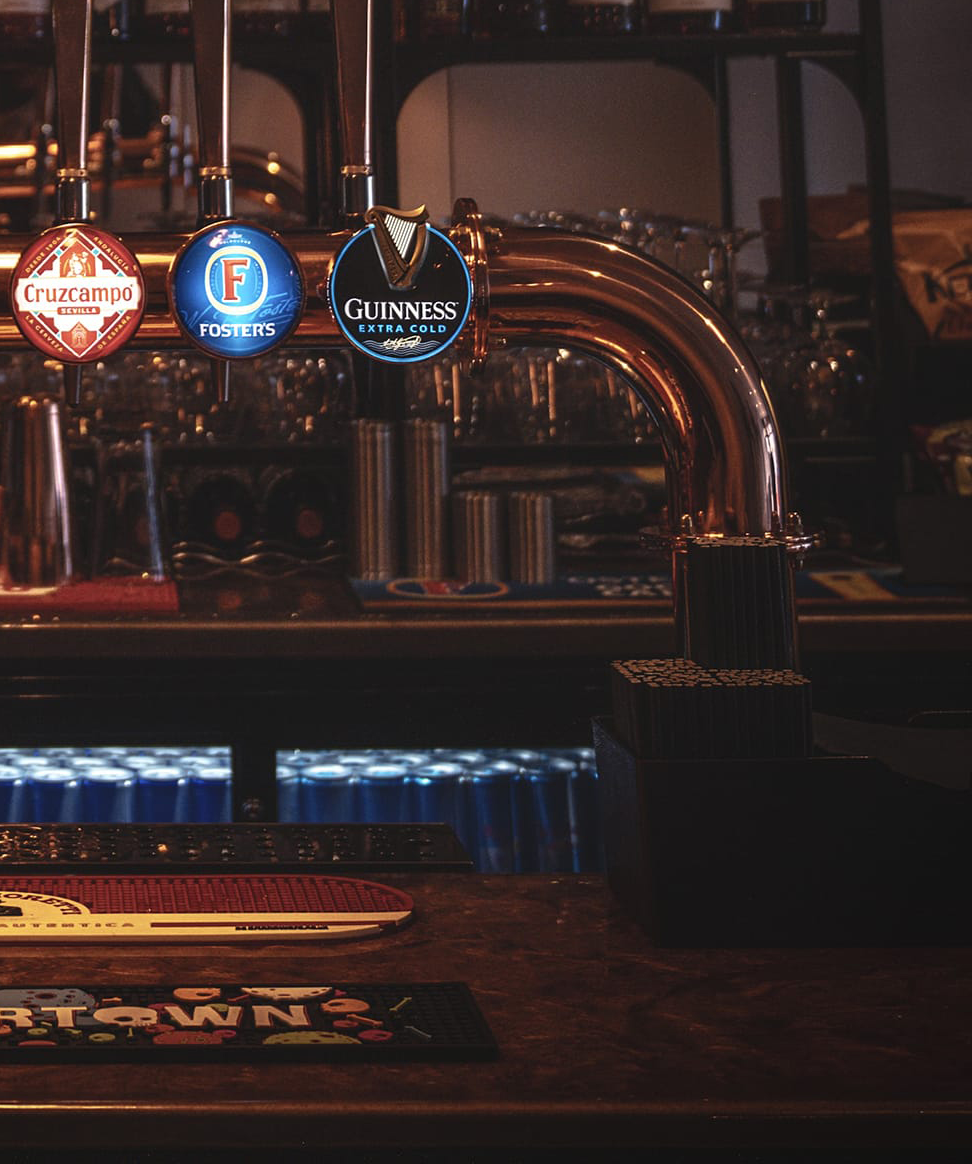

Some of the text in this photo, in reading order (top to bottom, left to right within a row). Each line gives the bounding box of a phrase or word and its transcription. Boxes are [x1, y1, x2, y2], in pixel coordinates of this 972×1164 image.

[221, 258, 249, 302] F
[24, 283, 133, 305] Cruzcampo
[344, 298, 458, 320] GUINNESS
[199, 322, 276, 337] FOSTER'S
[359, 324, 447, 333] EXTRA COLD
